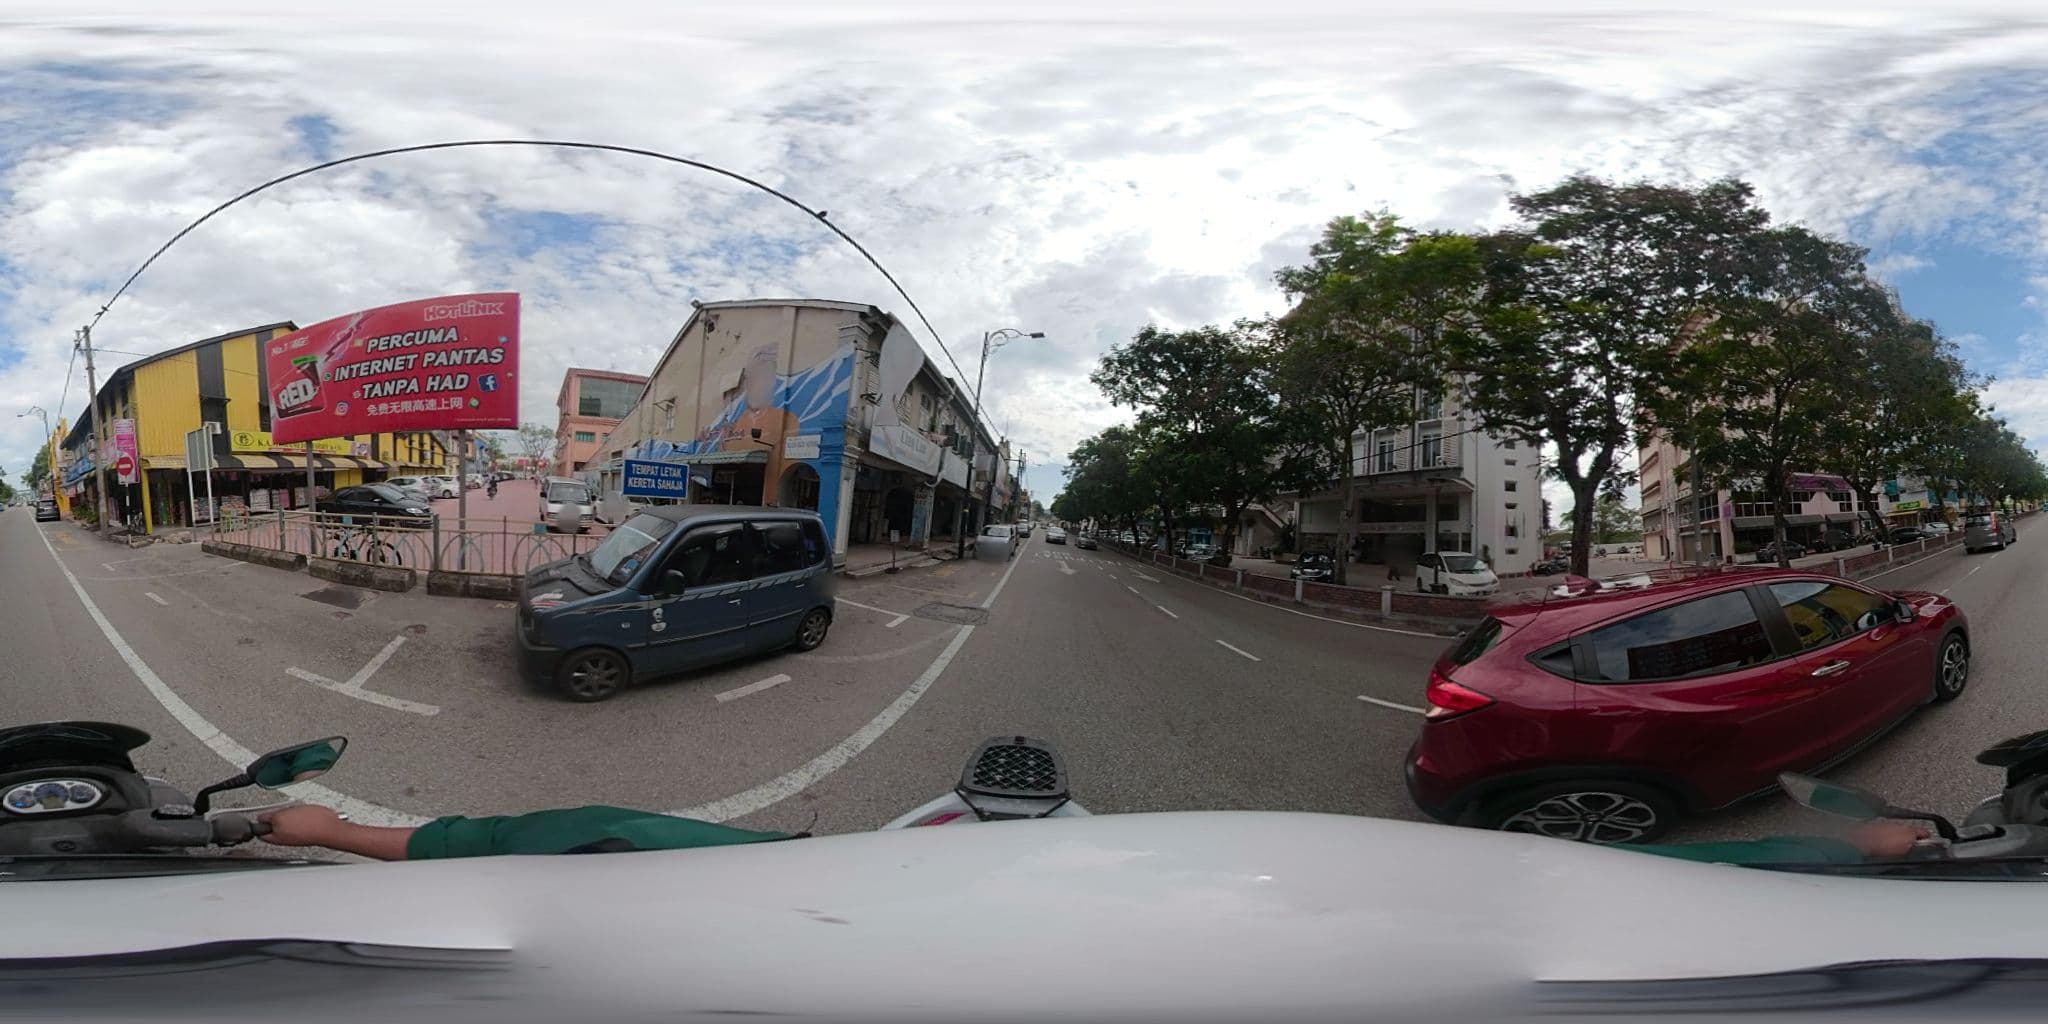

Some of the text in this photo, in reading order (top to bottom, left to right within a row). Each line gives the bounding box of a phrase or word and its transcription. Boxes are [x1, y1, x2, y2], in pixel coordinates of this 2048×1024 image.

[424, 300, 504, 321] HOTLINK
[366, 326, 458, 353] PERCUMA
[334, 348, 505, 382] INTERNET PANTAS
[278, 377, 317, 410] RED
[362, 373, 470, 399] TANPA HAD
[366, 397, 463, 416] 免费无限高速上网
[631, 463, 682, 478] TEMPAT LETAK
[627, 477, 684, 491] KERETA SAHAJA
